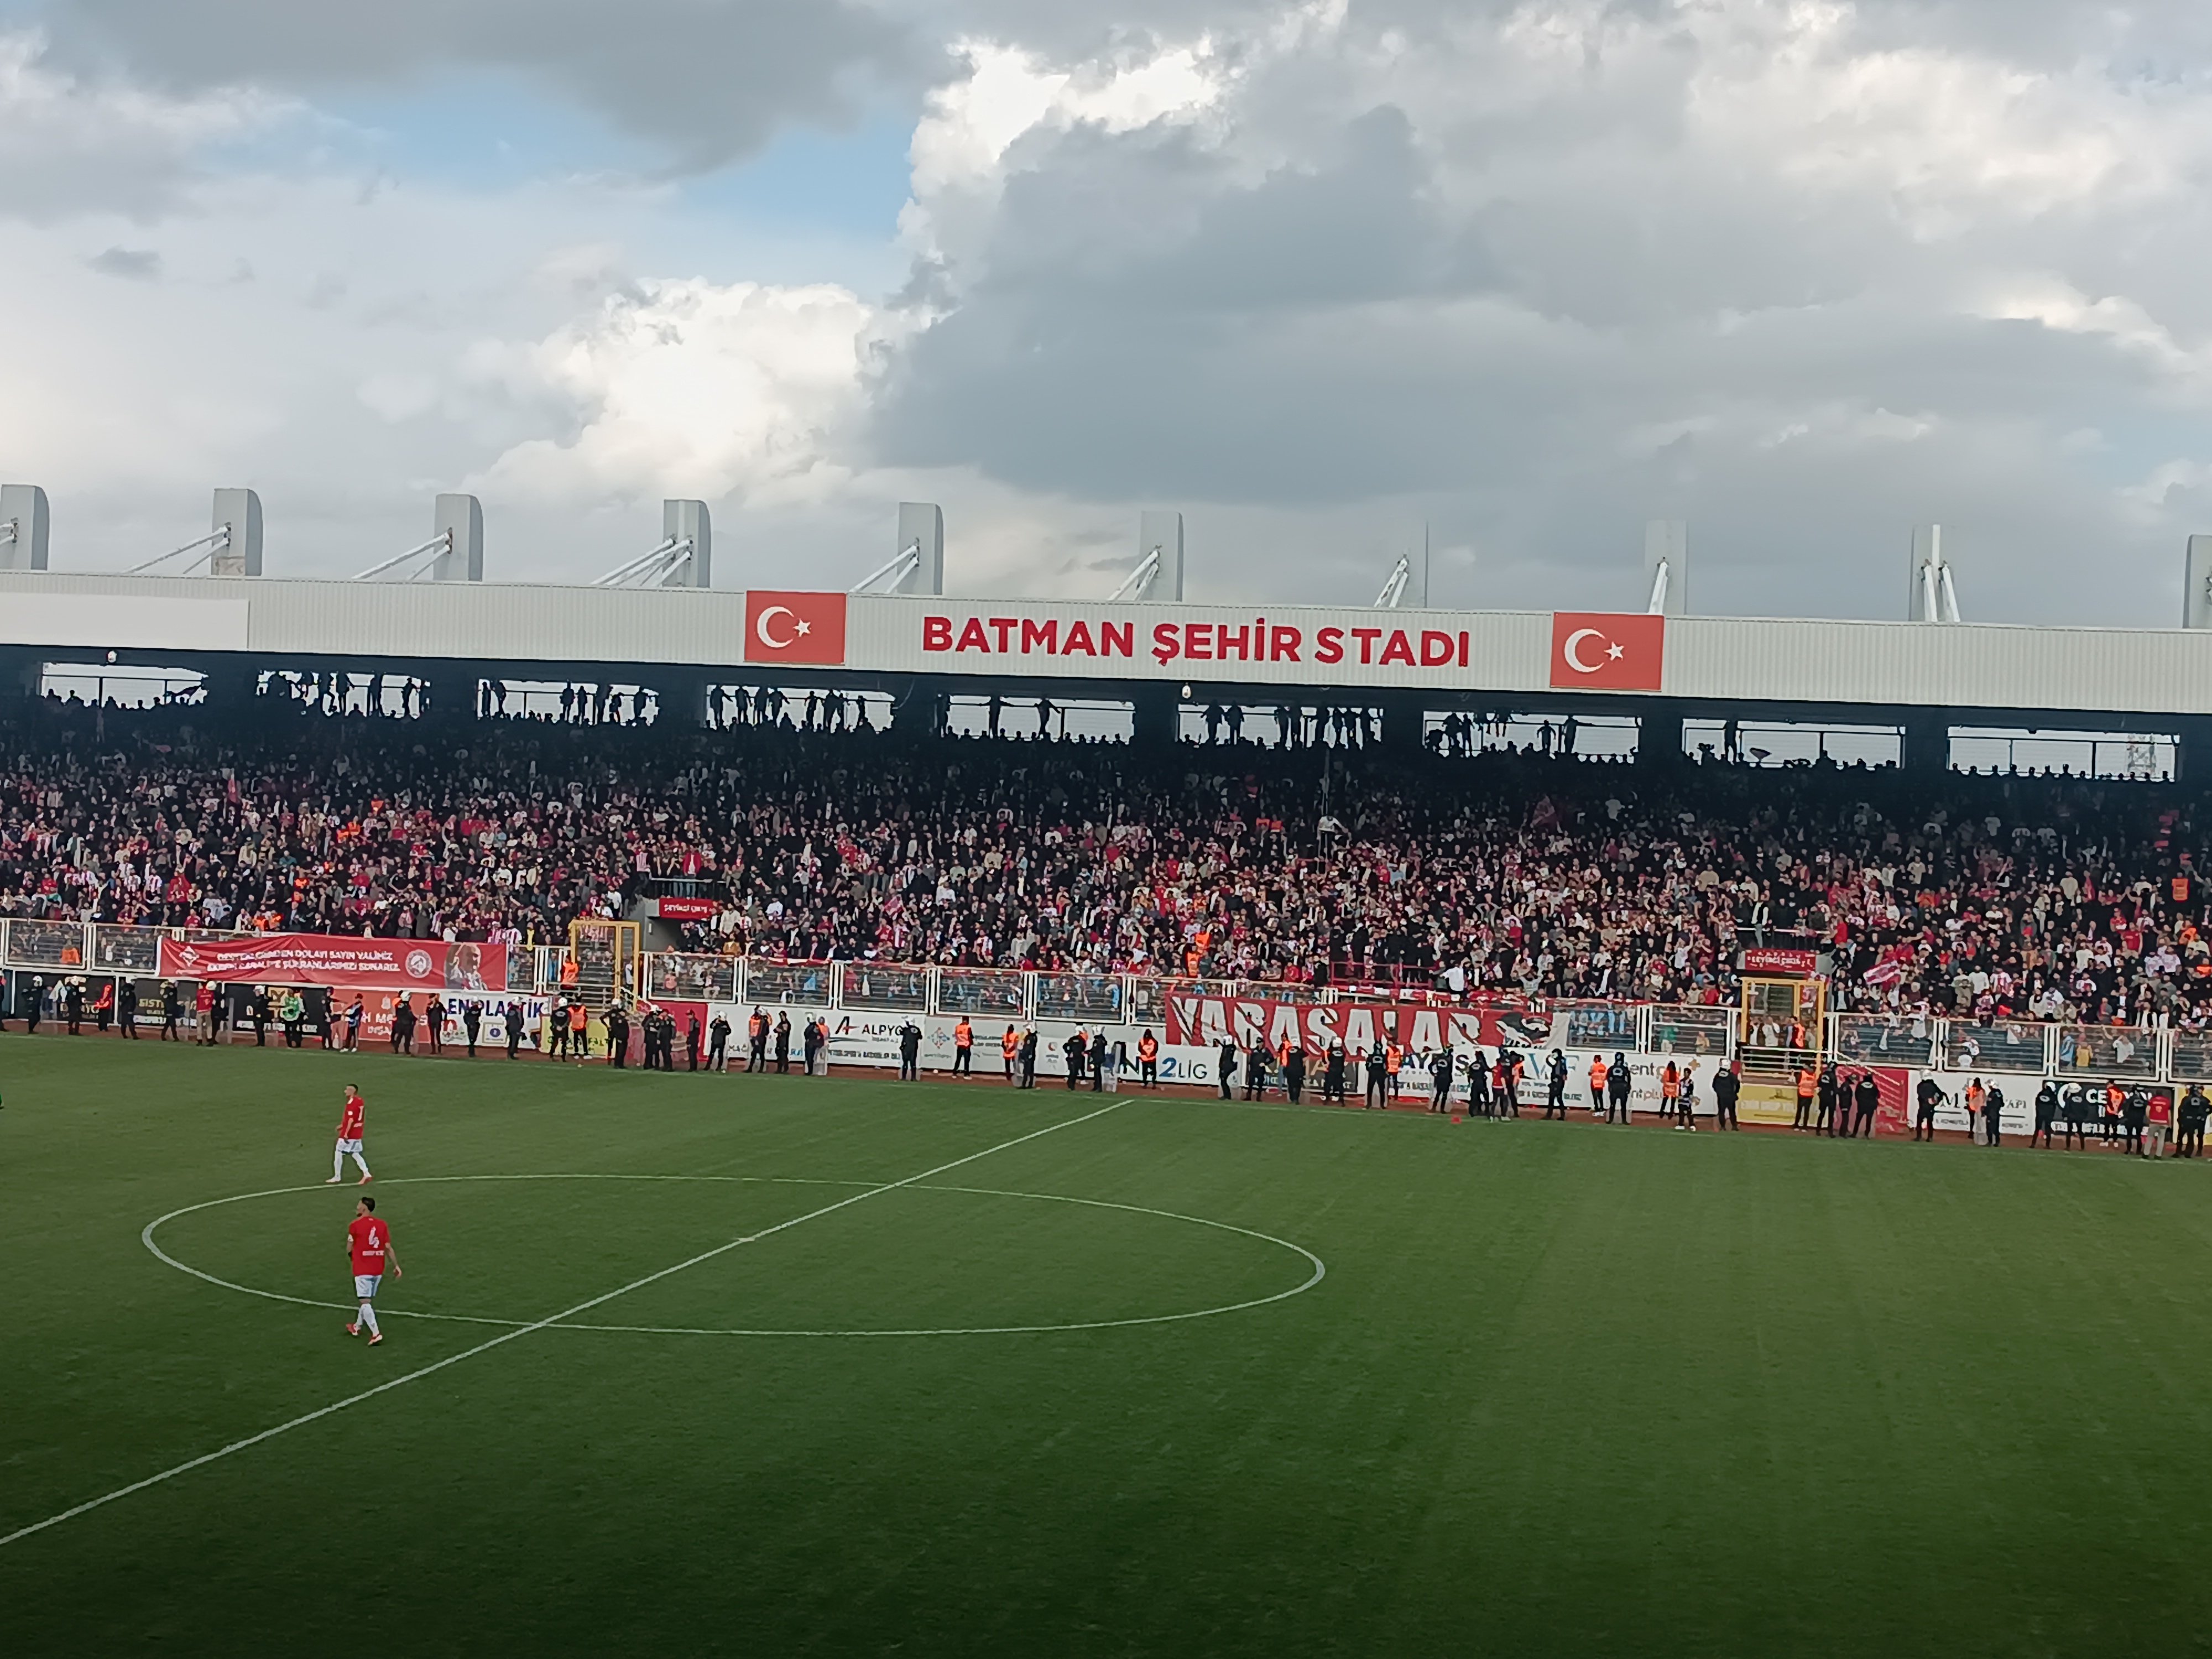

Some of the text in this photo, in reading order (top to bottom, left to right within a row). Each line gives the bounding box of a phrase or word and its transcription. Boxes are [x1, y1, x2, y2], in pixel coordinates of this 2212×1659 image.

[923, 617, 1469, 667] BATMAN ŞEHİR STADI
